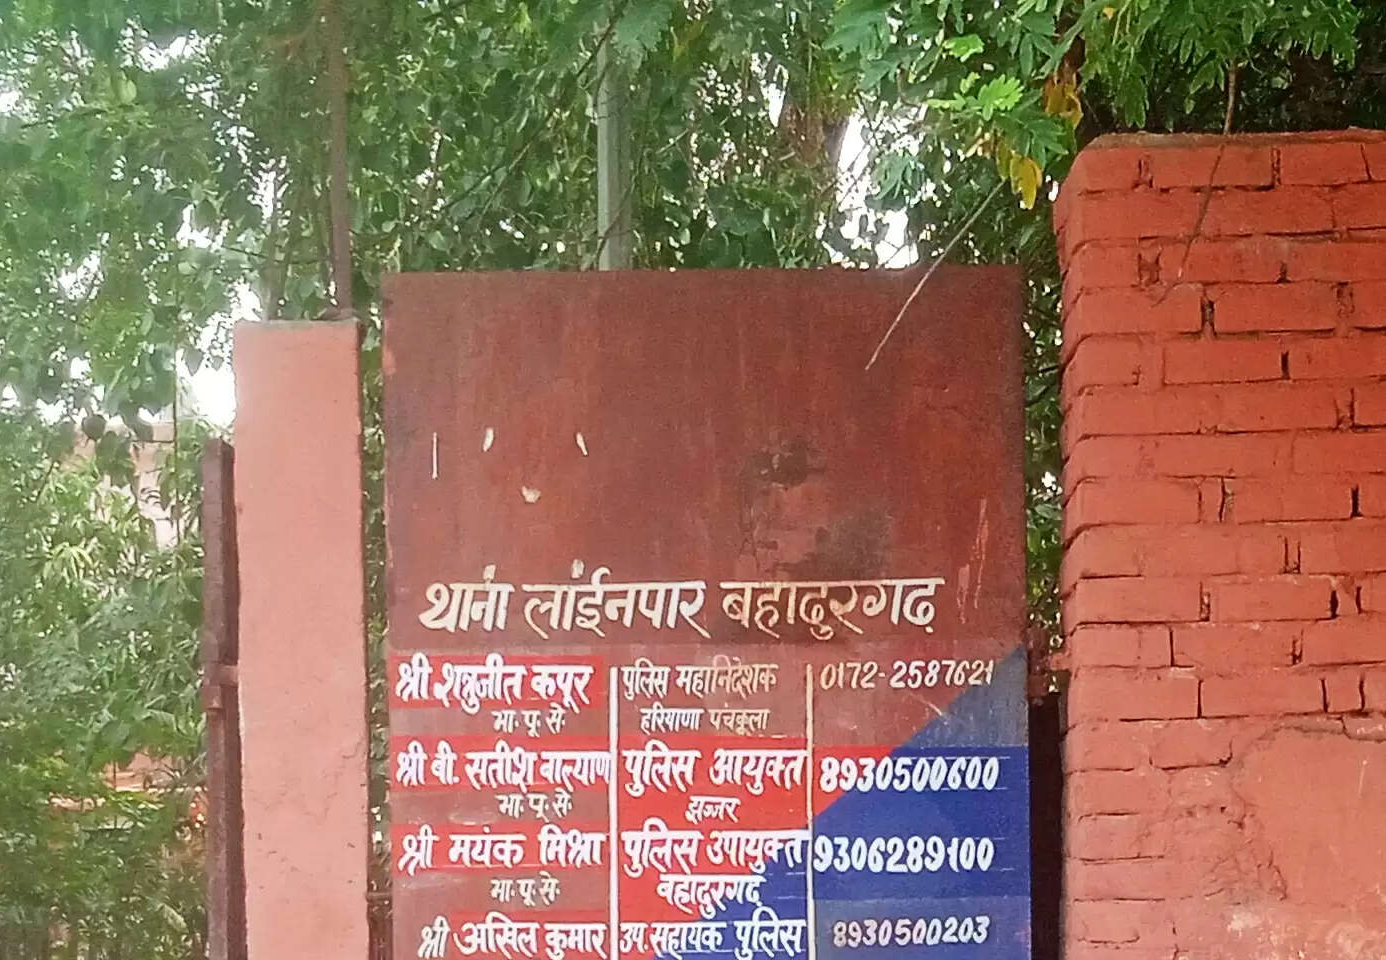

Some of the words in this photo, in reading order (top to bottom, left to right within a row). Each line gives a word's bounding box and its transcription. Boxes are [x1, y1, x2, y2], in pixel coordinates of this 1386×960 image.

[719, 577, 945, 640] बहादुरगढ़
[396, 652, 433, 701] श्री
[530, 664, 594, 713] कपूर
[621, 657, 671, 700] पुलिस
[675, 655, 779, 699] महानिदेशक
[820, 660, 994, 690] 0172-2587621
[640, 702, 705, 735] हरियाणा
[708, 702, 771, 736] पंचकूला
[396, 740, 428, 787] श्री
[465, 740, 537, 793] सतीश
[621, 739, 701, 797] पुलिस
[709, 748, 808, 795] आयुक्त
[819, 756, 1000, 792] 8930500600
[685, 795, 741, 824] झज्जर
[397, 824, 440, 876] श्री
[449, 825, 527, 868] मयंक
[538, 824, 607, 868] मिश्रा
[621, 817, 704, 877] पुलिस
[706, 830, 811, 873] उपायुक्त
[813, 835, 994, 873] 9306289100
[657, 873, 767, 919] बहादुरगढ़
[417, 915, 451, 959] श्री
[453, 911, 540, 960] अखिल
[544, 922, 608, 960] कुमार
[832, 916, 990, 947] 8930500203
